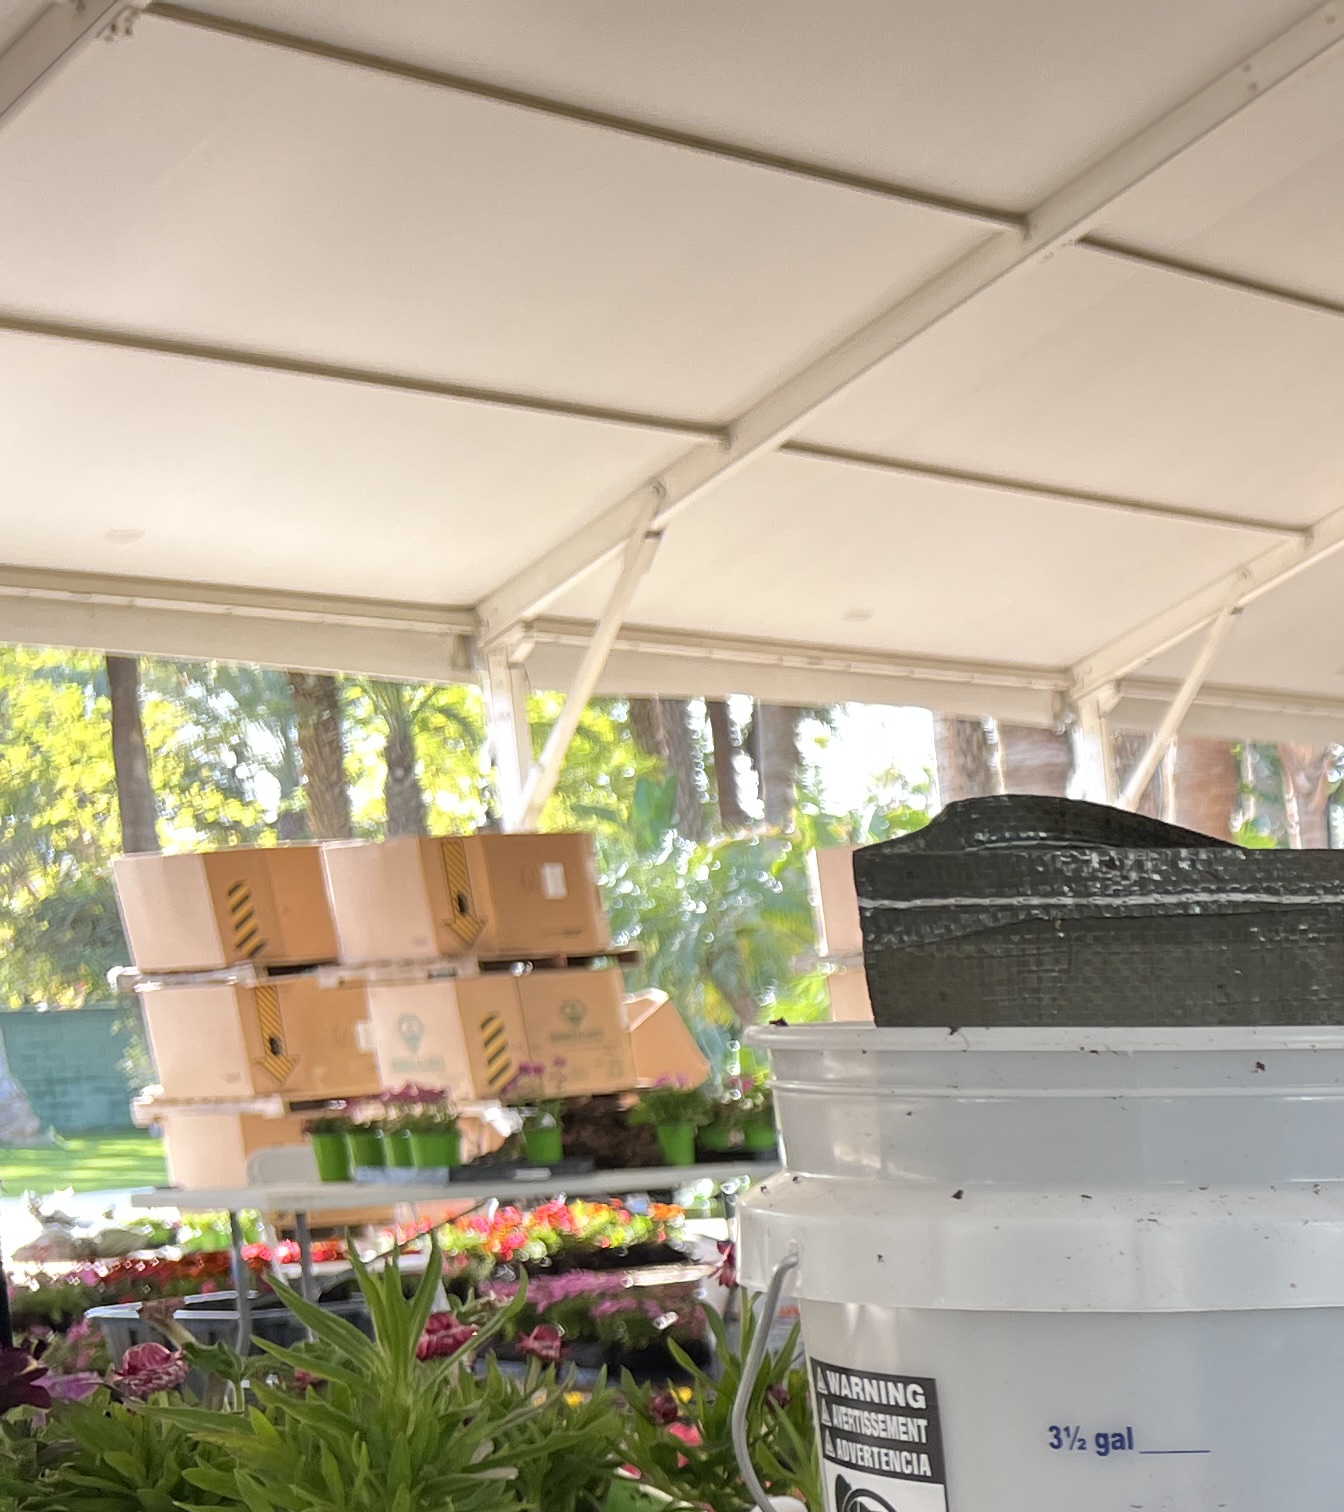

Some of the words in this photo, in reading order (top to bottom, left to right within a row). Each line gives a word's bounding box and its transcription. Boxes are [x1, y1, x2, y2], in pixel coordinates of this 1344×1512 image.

[826, 1370, 926, 1409] WARNING
[832, 1404, 928, 1443] AVERTISSEMENT
[1095, 1426, 1134, 1456] gal
[836, 1438, 932, 1477] ADVERTENCIA
